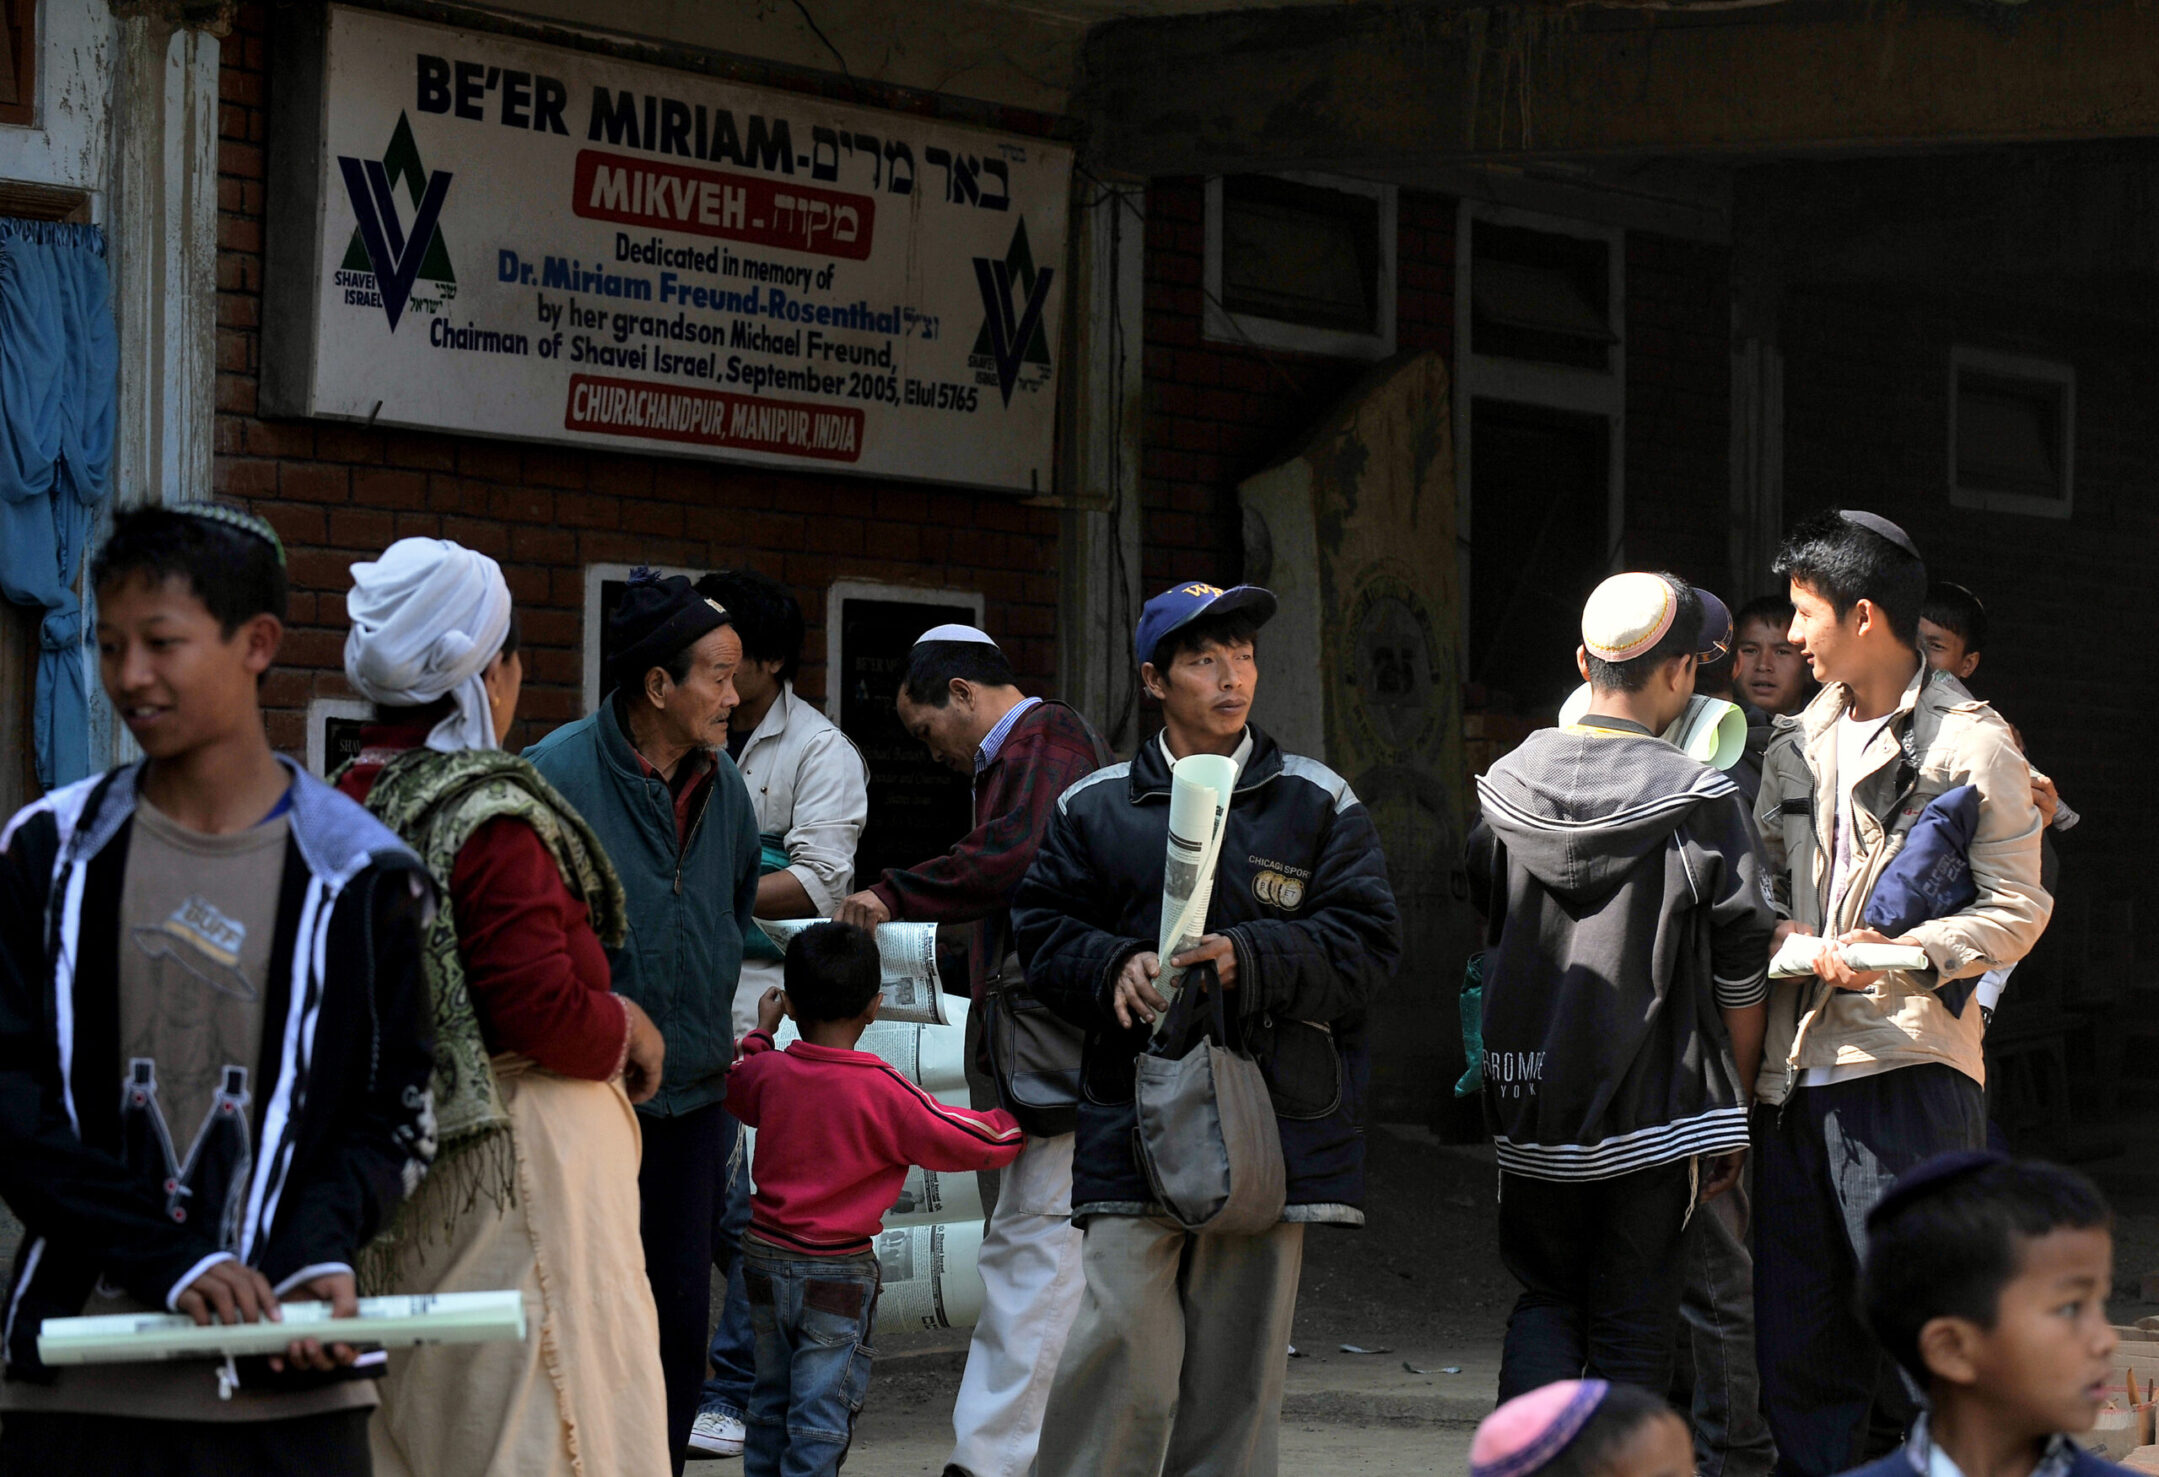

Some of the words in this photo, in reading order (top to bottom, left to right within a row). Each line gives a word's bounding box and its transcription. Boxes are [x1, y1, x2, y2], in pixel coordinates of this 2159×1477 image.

[417, 54, 570, 136] BE'ER
[925, 146, 1009, 211] באר
[334, 270, 375, 289] SHAVEI
[498, 249, 538, 286] Dr.
[542, 256, 651, 301] Miriam
[660, 272, 900, 334] Freund-Rosenthal
[616, 232, 718, 275] Dedicated
[723, 248, 738, 276] in
[743, 258, 812, 294] memory
[816, 263, 835, 290] of
[344, 289, 383, 308] ISRAEL
[538, 292, 562, 330] by
[570, 296, 608, 330] her
[613, 312, 724, 346] grandson
[730, 319, 800, 356] Michael
[807, 331, 897, 374] Freund,
[430, 318, 528, 355] Chairman
[538, 332, 562, 359] of
[570, 335, 647, 371] Shavei
[726, 355, 845, 395] September
[848, 372, 900, 406] 2005,
[904, 379, 936, 408] Elul
[938, 383, 978, 412] 5765
[572, 382, 727, 440] CHURACHANDPUR,
[729, 402, 810, 450] MANIPUR,
[812, 413, 856, 452] INDIA
